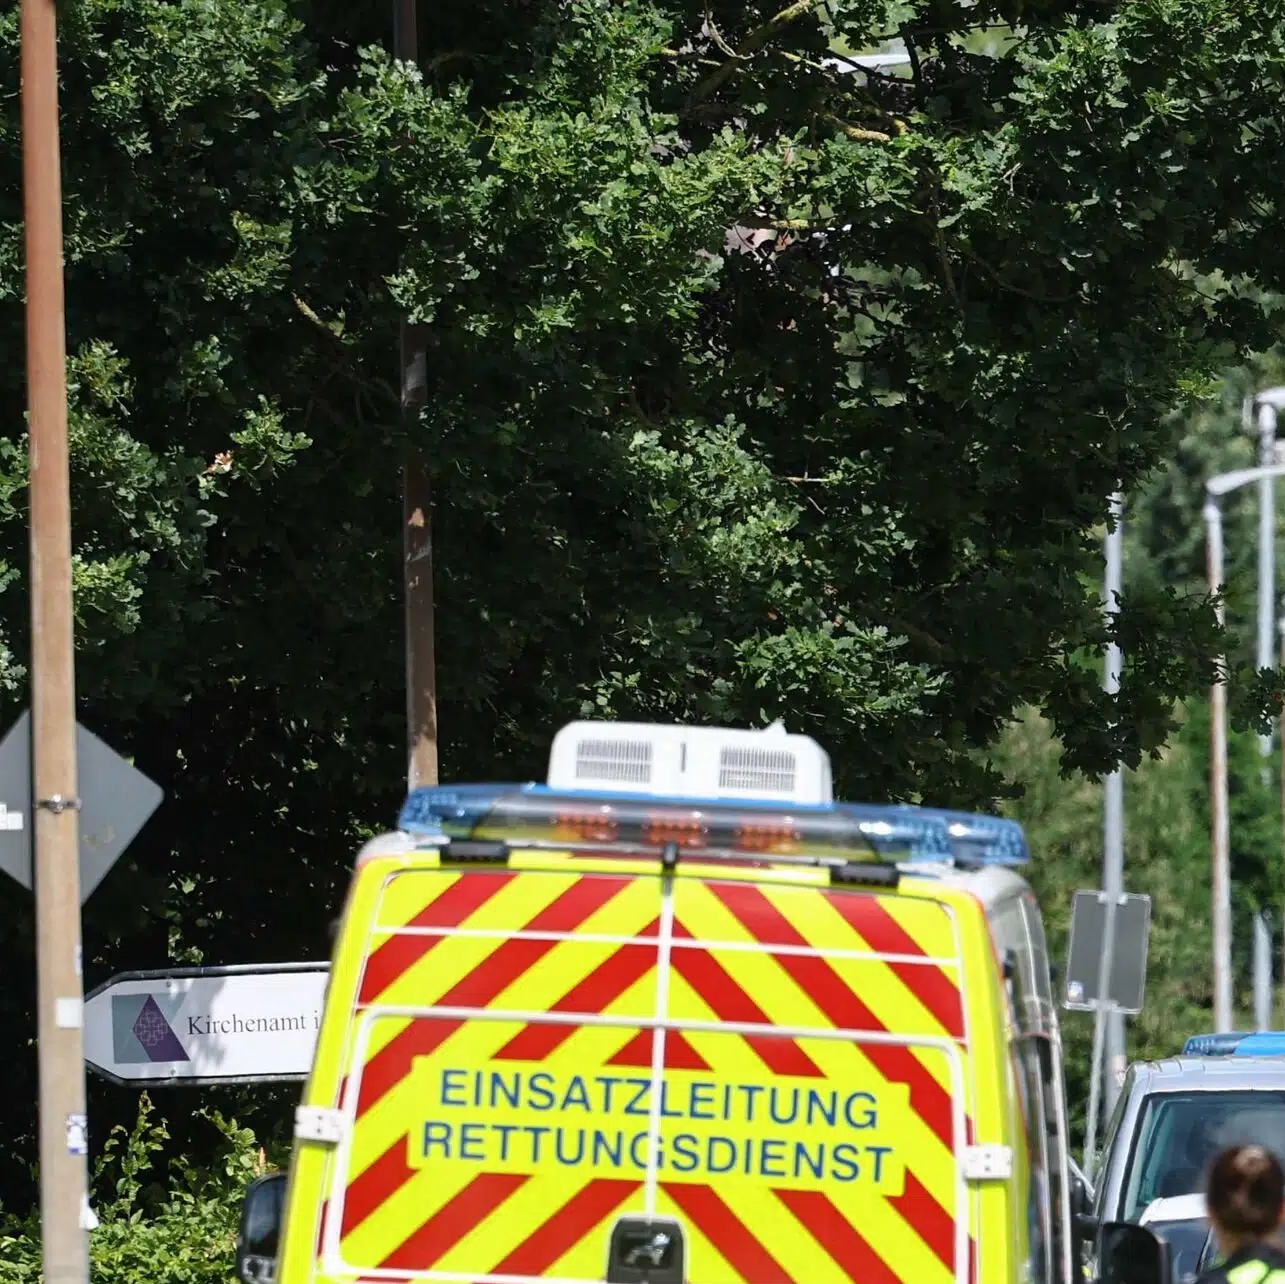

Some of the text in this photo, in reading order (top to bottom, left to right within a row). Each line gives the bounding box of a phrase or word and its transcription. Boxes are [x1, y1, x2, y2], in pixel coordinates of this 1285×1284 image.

[186, 1013, 307, 1036] Kirchenamt
[440, 1068, 878, 1129] EINSATZLEITUNG
[421, 1120, 893, 1183] RETTUNGSDIENST
